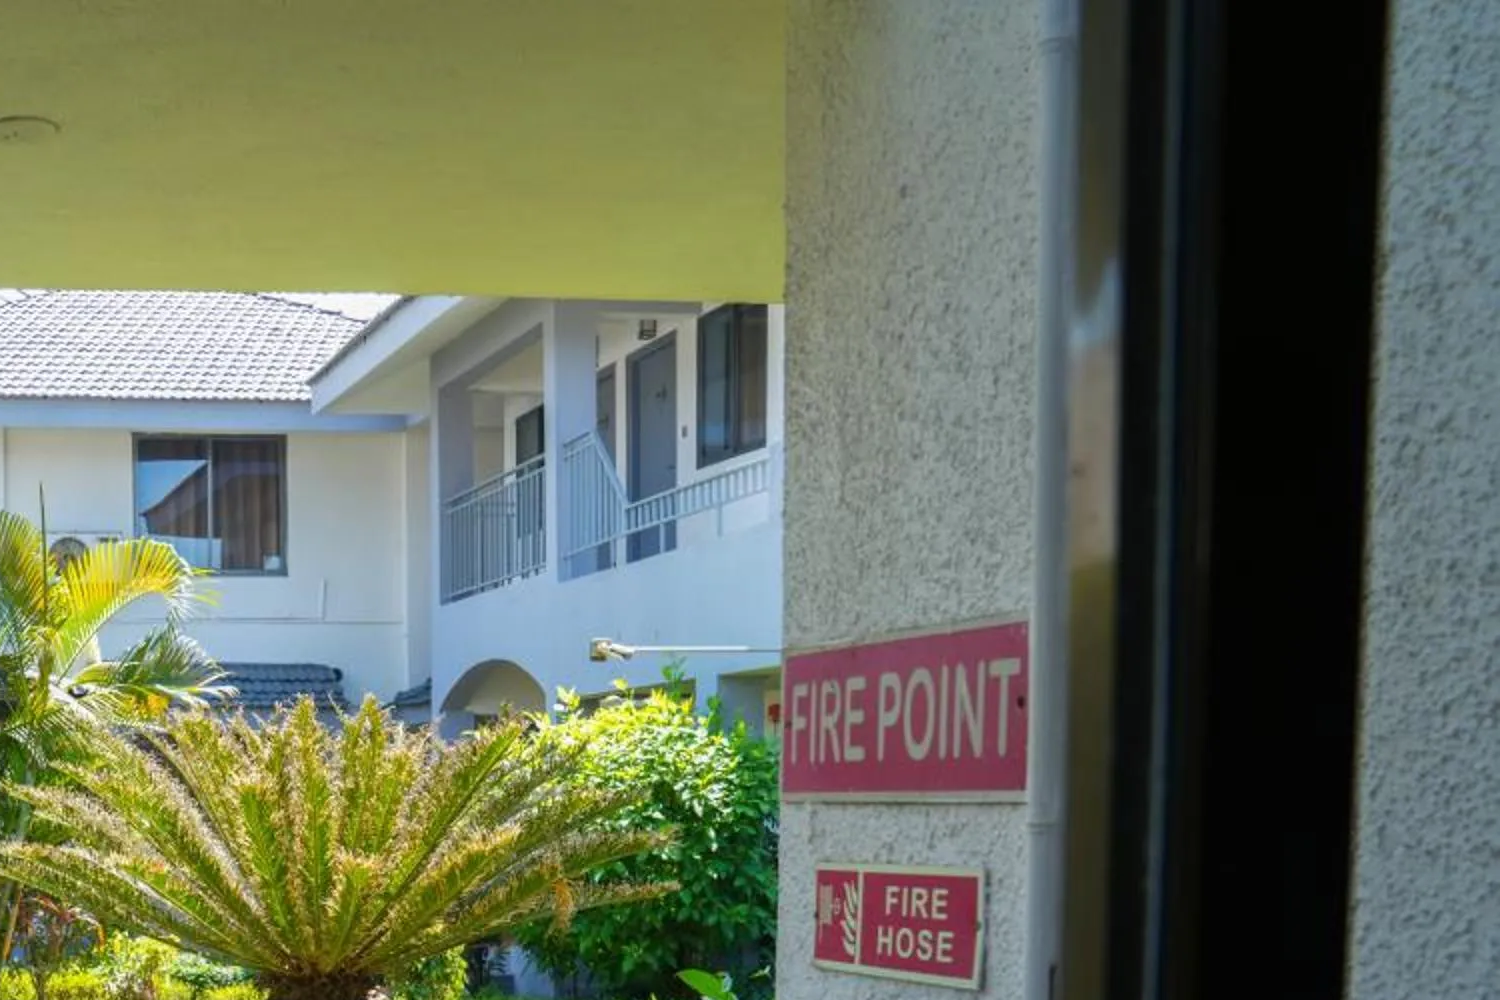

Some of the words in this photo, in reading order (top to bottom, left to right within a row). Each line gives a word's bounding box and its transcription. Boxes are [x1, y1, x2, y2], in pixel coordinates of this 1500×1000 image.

[790, 676, 867, 765] FIRE
[877, 657, 1022, 763] POINT
[885, 885, 949, 921] FIRE
[876, 925, 955, 963] HOSE
